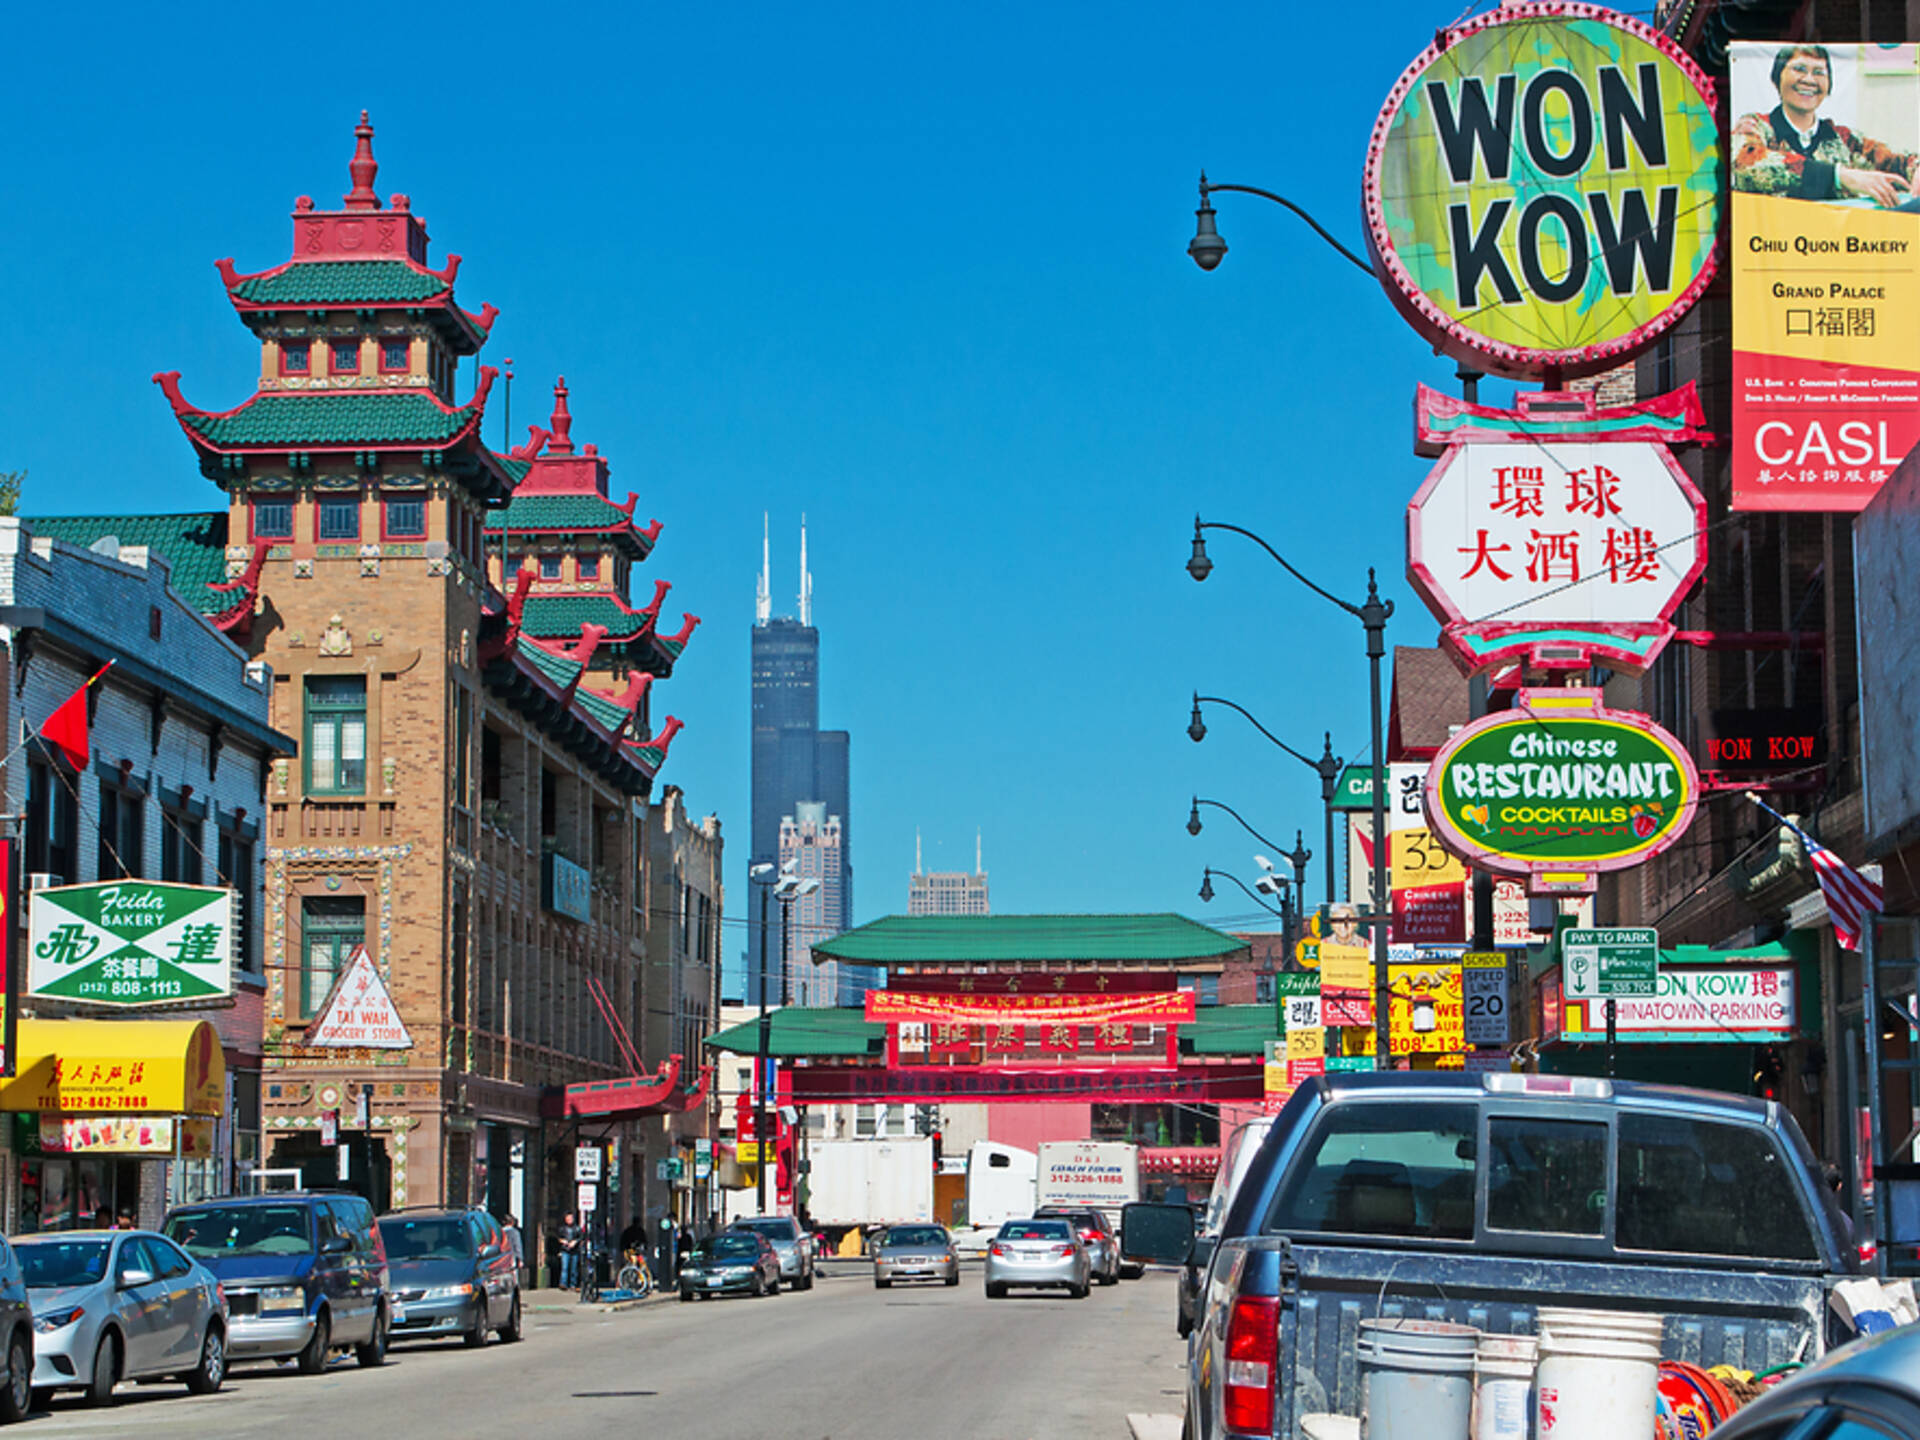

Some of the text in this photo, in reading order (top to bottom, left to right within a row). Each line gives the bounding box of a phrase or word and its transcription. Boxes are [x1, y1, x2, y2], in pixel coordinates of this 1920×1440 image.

[1426, 62, 1667, 184] WON
[1448, 185, 1680, 309] KOW
[1786, 307, 1875, 337] 口福閣
[1754, 420, 1905, 466] CASL
[1490, 465, 1622, 518] 環球
[1457, 527, 1660, 584] 大酒樓
[1508, 732, 1618, 758] Chinese
[1706, 736, 1814, 760] WON KOW
[1450, 762, 1675, 799] RESTAURANT
[1500, 806, 1628, 823] COCKTAILS
[1404, 831, 1449, 871] 35
[98, 887, 165, 913] Feida
[101, 914, 165, 927] BAKERY
[1571, 932, 1649, 944] PAY TO PARK
[1465, 955, 1504, 966] SCHOOL
[1467, 971, 1504, 981] SPEED
[1656, 975, 1688, 996] ON
[1696, 975, 1748, 996] KOW
[79, 982, 107, 994] (312)
[1470, 982, 1500, 993] LIMIT
[1469, 995, 1504, 1016] 20
[1600, 1002, 1784, 1021] CHINATOWN PARKING
[337, 1010, 389, 1025] TAI WAH
[322, 1026, 402, 1040] GROCERY STORE
[578, 1151, 597, 1159] ONE
